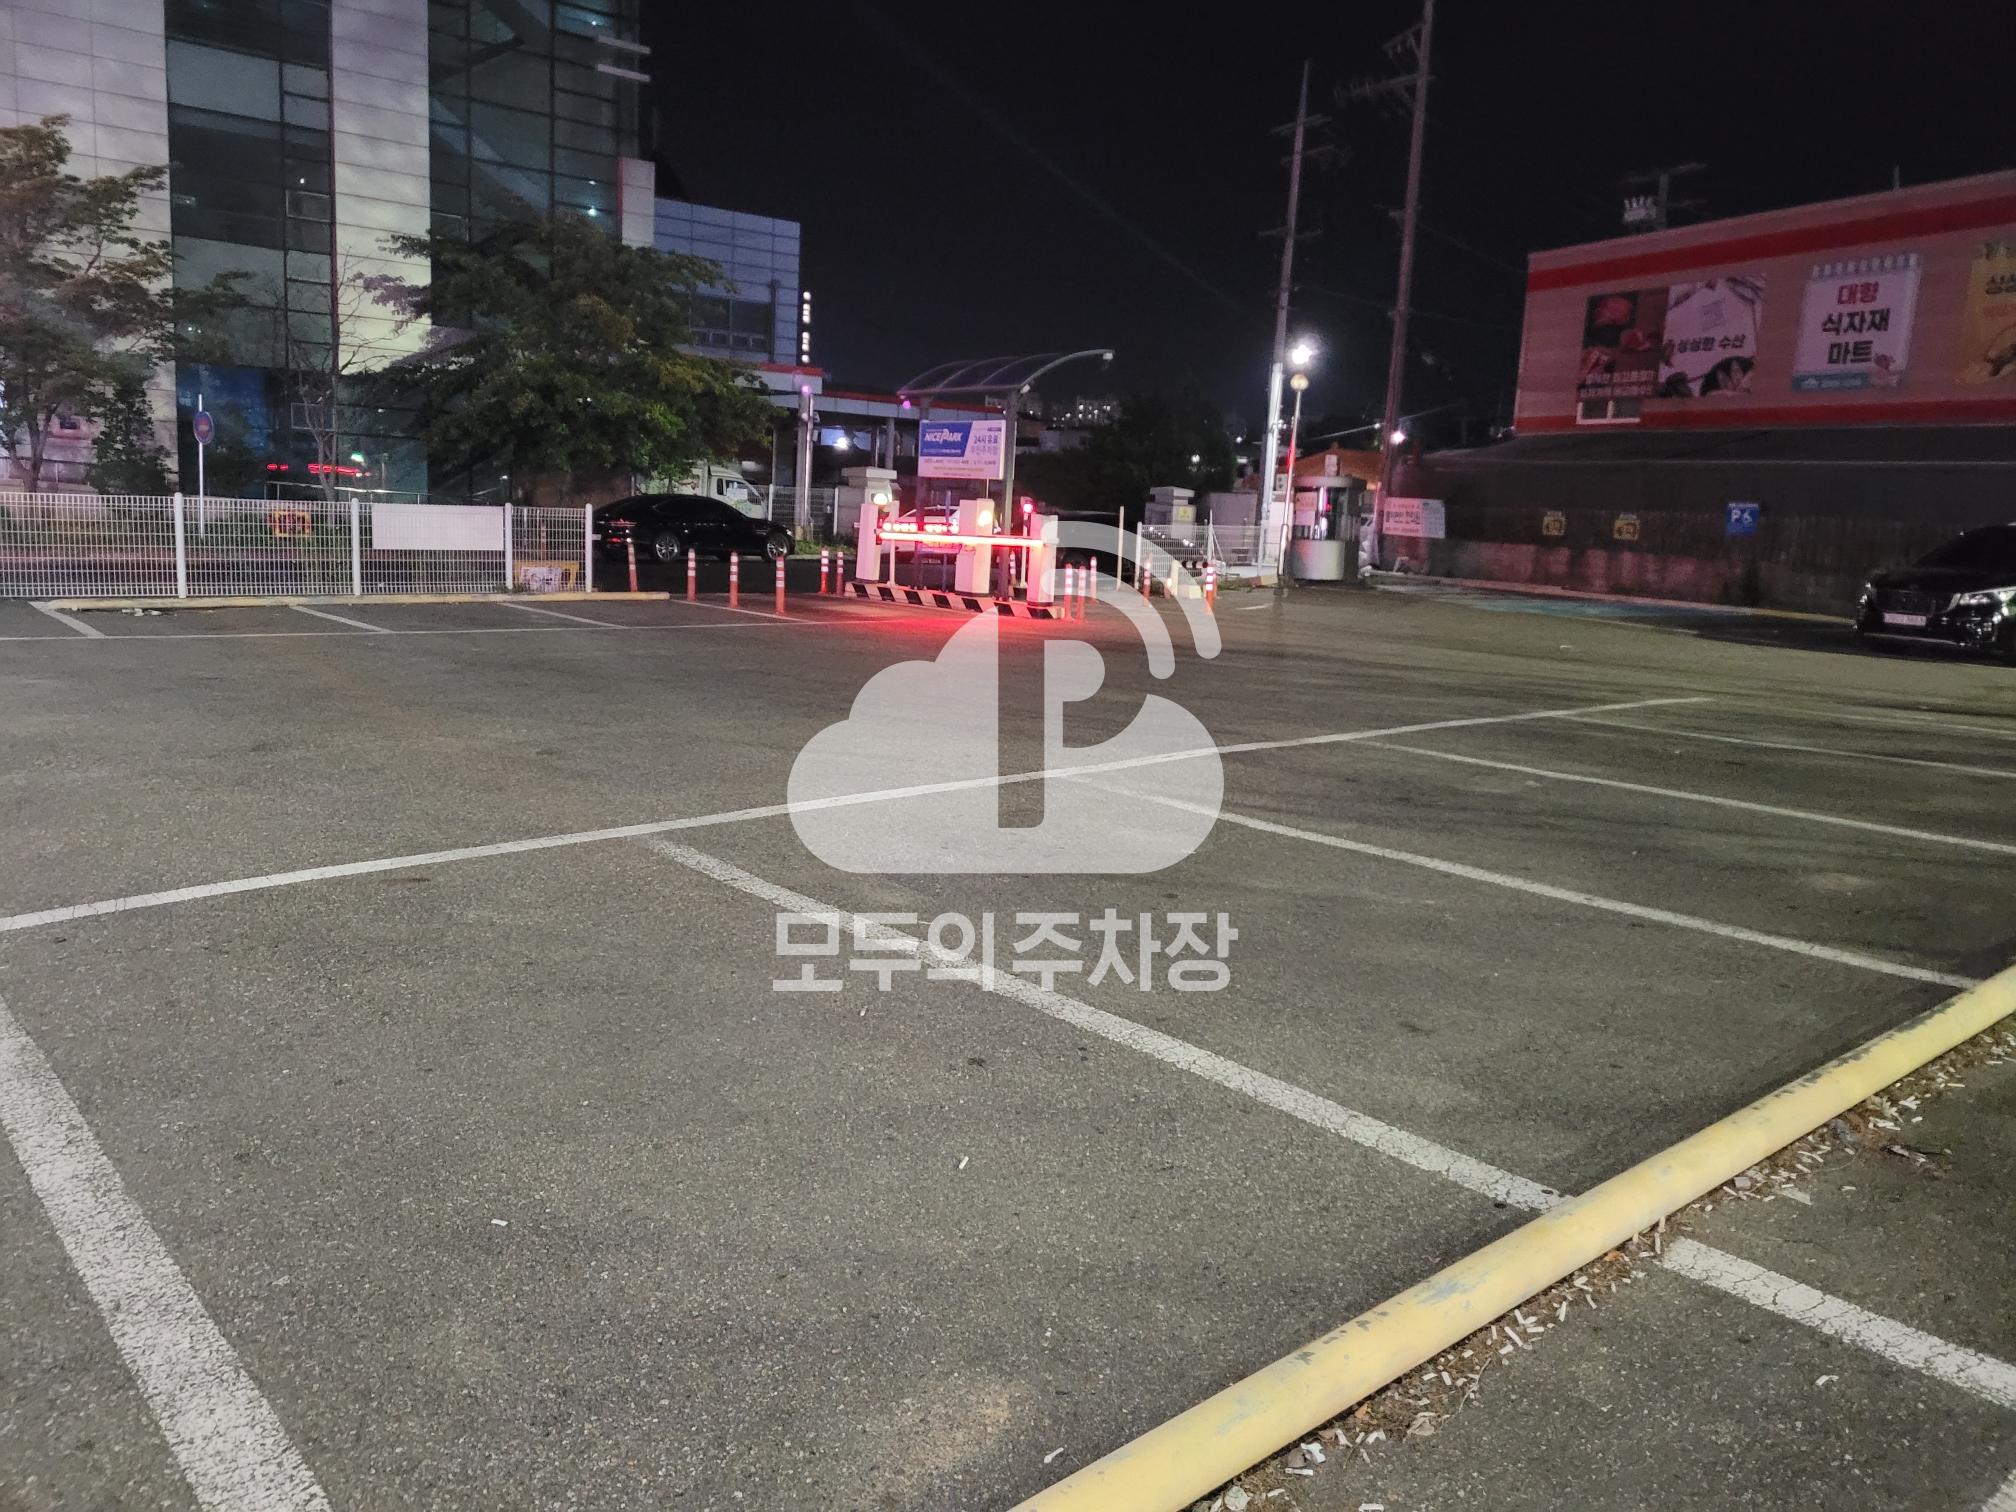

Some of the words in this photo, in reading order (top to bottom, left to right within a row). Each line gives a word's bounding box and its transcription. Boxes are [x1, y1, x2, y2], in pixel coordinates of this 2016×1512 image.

[1838, 281, 1880, 305] 대형
[1821, 307, 1891, 336] 식자재
[1827, 340, 1874, 365] 마트
